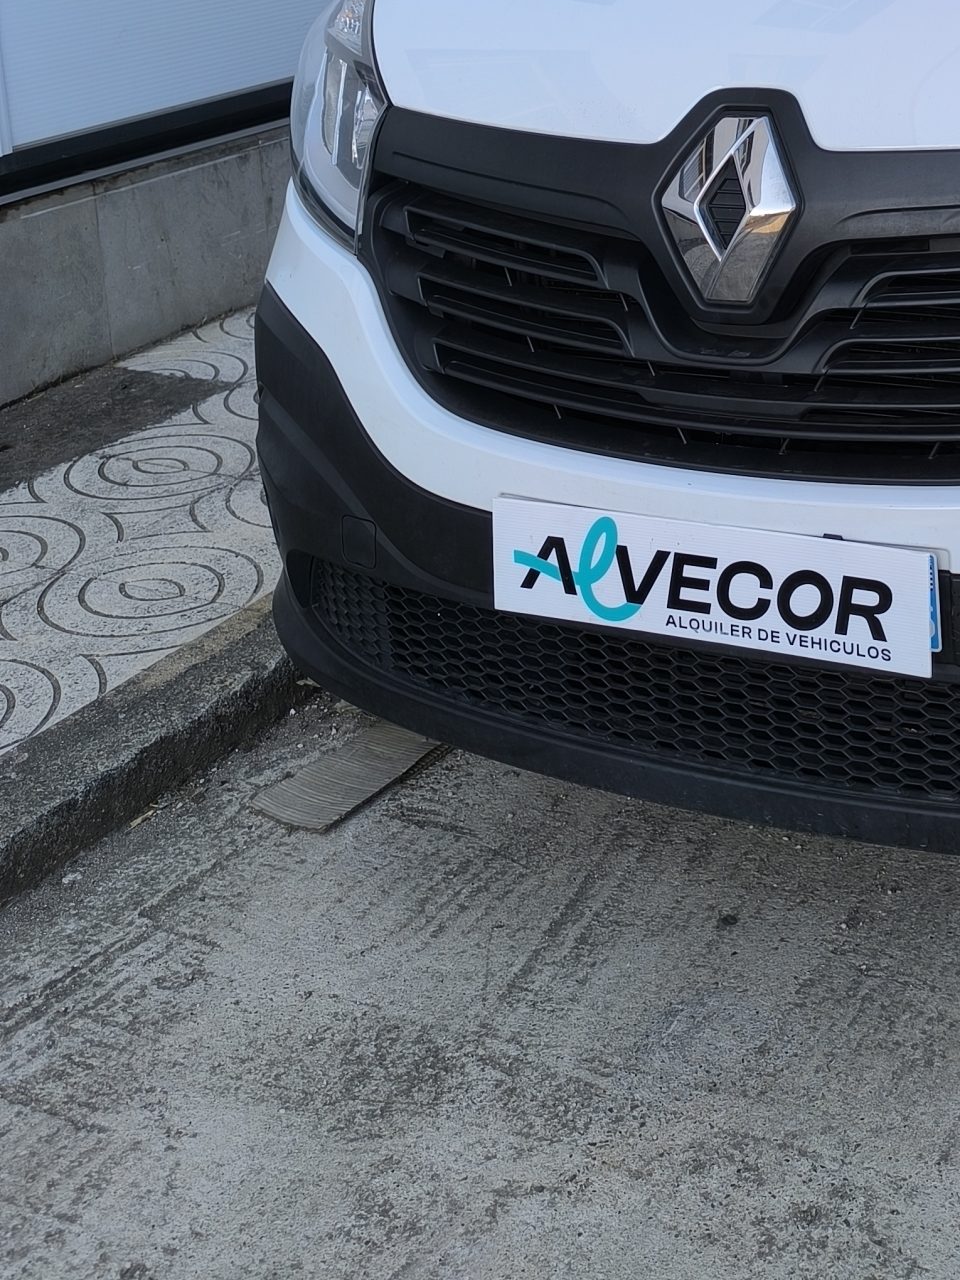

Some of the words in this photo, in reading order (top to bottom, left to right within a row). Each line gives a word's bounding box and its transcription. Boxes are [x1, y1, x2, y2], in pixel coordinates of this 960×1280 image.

[665, 614, 752, 640] ALQUILER
[757, 627, 781, 645] DE
[785, 632, 893, 663] VEHICULOS
